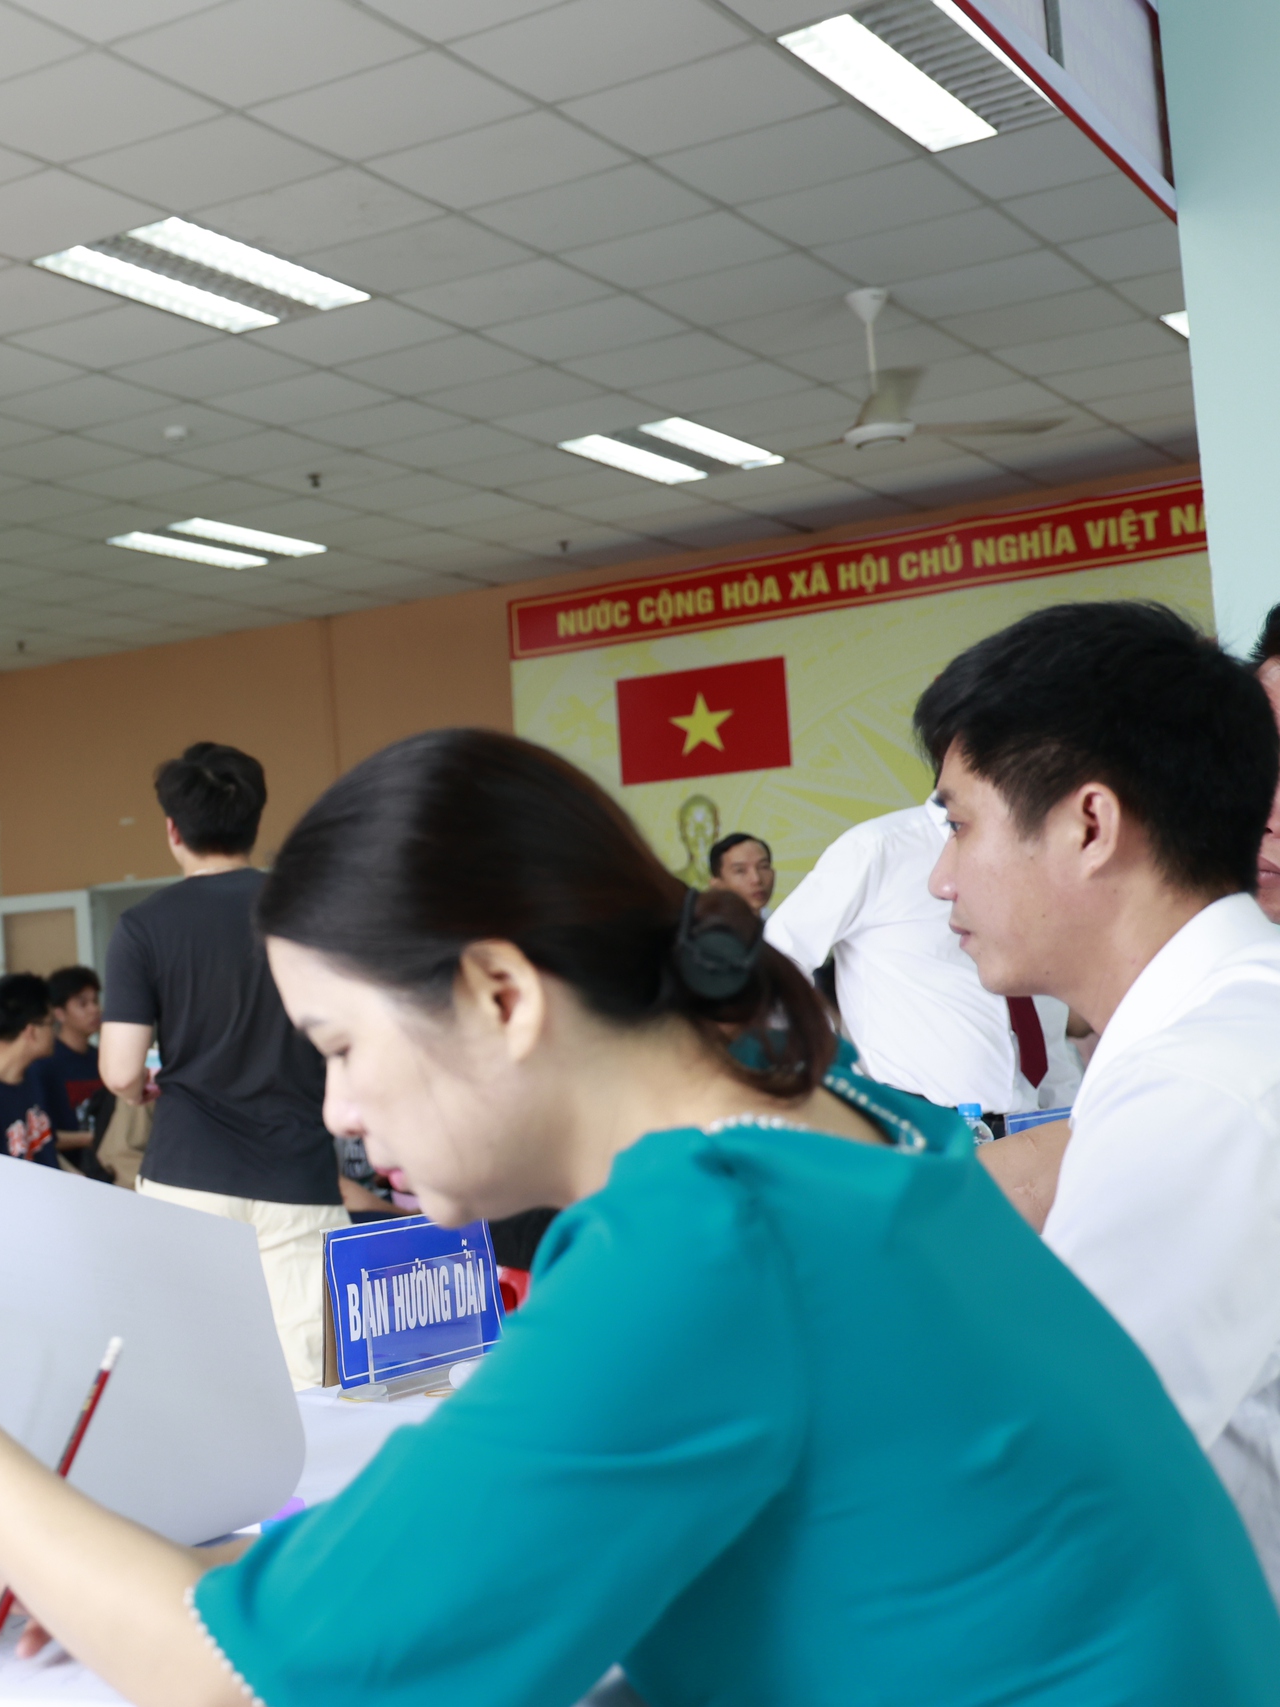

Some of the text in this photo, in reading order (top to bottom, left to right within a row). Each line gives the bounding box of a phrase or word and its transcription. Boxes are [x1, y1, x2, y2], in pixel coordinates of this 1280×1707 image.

[556, 598, 632, 638] NƯỚC
[637, 587, 715, 627] CỘNG
[721, 572, 782, 610] HÒA
[788, 561, 831, 599] XÃ
[837, 552, 890, 593] HỘI
[898, 533, 963, 581] CHỦ
[972, 522, 1077, 568] NGHĨA
[1084, 507, 1159, 551] VIỆT
[347, 1238, 487, 1342] BÀN HƯỚNG DẪN
